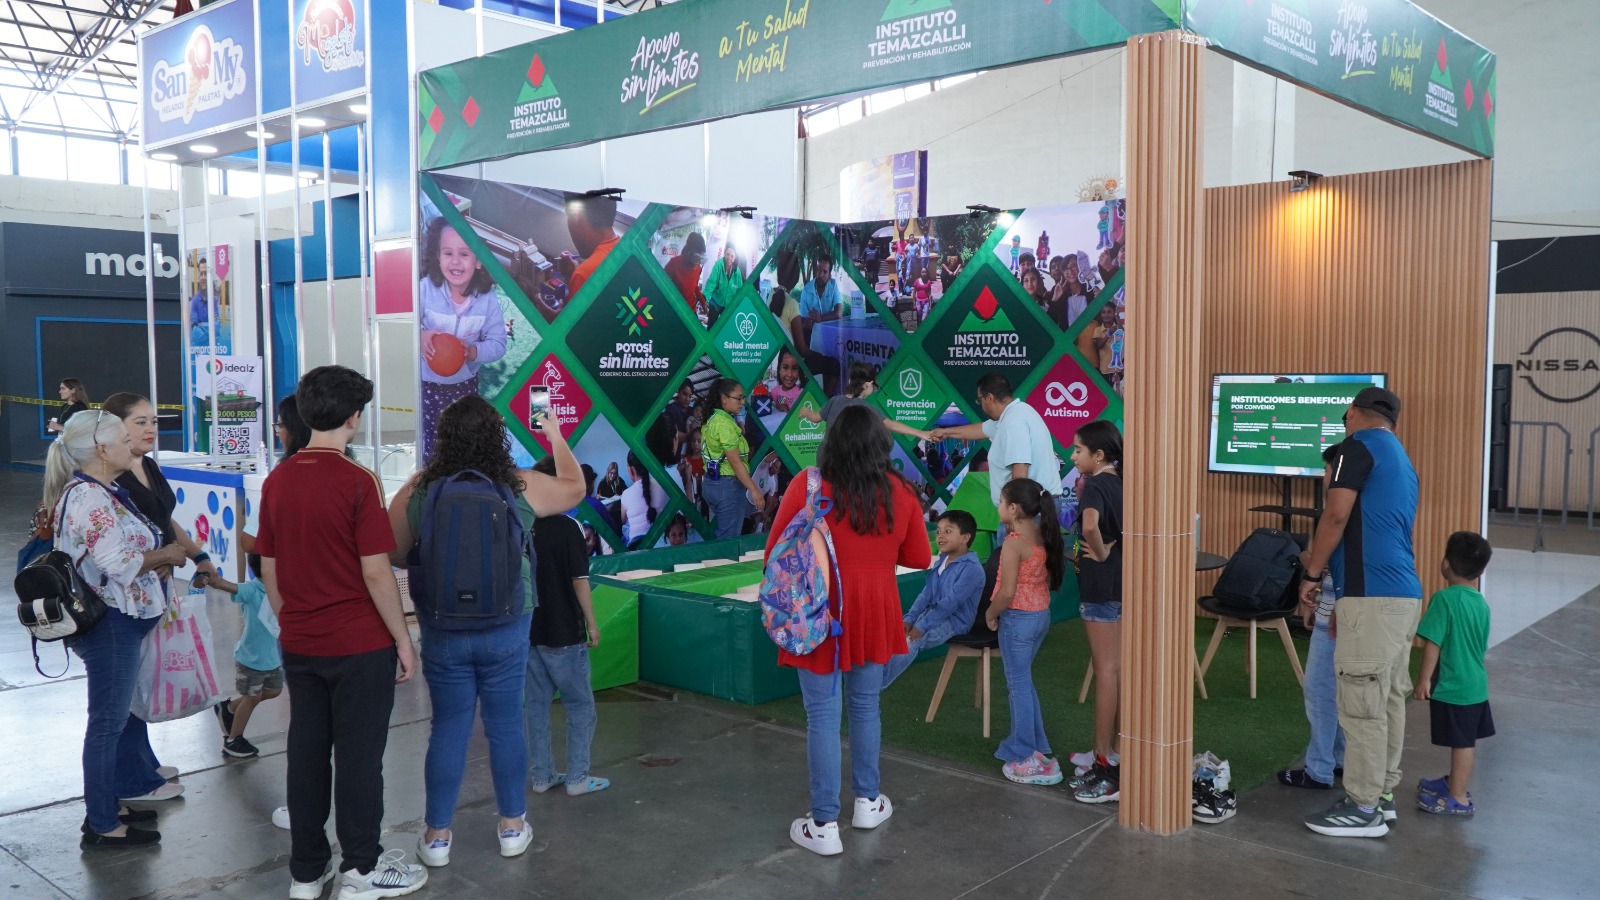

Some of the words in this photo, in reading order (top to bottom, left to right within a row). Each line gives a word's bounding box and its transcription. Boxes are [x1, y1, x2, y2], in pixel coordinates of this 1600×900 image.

[876, 9, 956, 40] INSTITUTO
[1271, 2, 1312, 34] INSTITUTO
[1337, 0, 1368, 34] Apoyo
[719, 36, 732, 58] a
[736, 20, 759, 50] Tu
[764, 0, 810, 40] Salud
[868, 24, 966, 57] TEMAZCALLI
[1266, 18, 1316, 54] TEMAZCALLI
[630, 31, 680, 71] Apoyo
[1330, 29, 1349, 57] sin
[1402, 28, 1422, 64] Salud
[735, 36, 788, 83] Mental
[862, 54, 906, 68] PREVENCIÓN
[912, 42, 972, 60] REHABILITACIÓN
[154, 68, 187, 102] San
[214, 46, 239, 90] My
[620, 74, 646, 103] sin
[645, 49, 699, 108] límites
[162, 102, 184, 113] HELADOS
[198, 90, 220, 102] PALETAS
[1428, 82, 1455, 104] INSTITUTO
[514, 96, 561, 117] INSTITUTO
[1425, 94, 1458, 118] TEMAZCALLI
[510, 108, 567, 130] TEMAZCALLI
[506, 129, 532, 139] PREVENCIÓN
[86, 243, 179, 278] mab
[190, 343, 228, 354] omproiso
[724, 341, 744, 349] Salud
[746, 342, 769, 350] mental
[954, 334, 1019, 345] INSTITUTO
[599, 352, 620, 368] sin
[622, 354, 669, 368] límites
[948, 346, 1026, 358] TEMAZCALLI
[224, 364, 254, 372] idealz
[1516, 360, 1599, 371] NISSA
[550, 403, 576, 415] lisis
[886, 399, 936, 408] Prevención
[1231, 396, 1296, 404] INSTITUCIONES
[559, 416, 578, 424] gicos
[1044, 407, 1090, 418] Autismo
[210, 527, 229, 563] My
